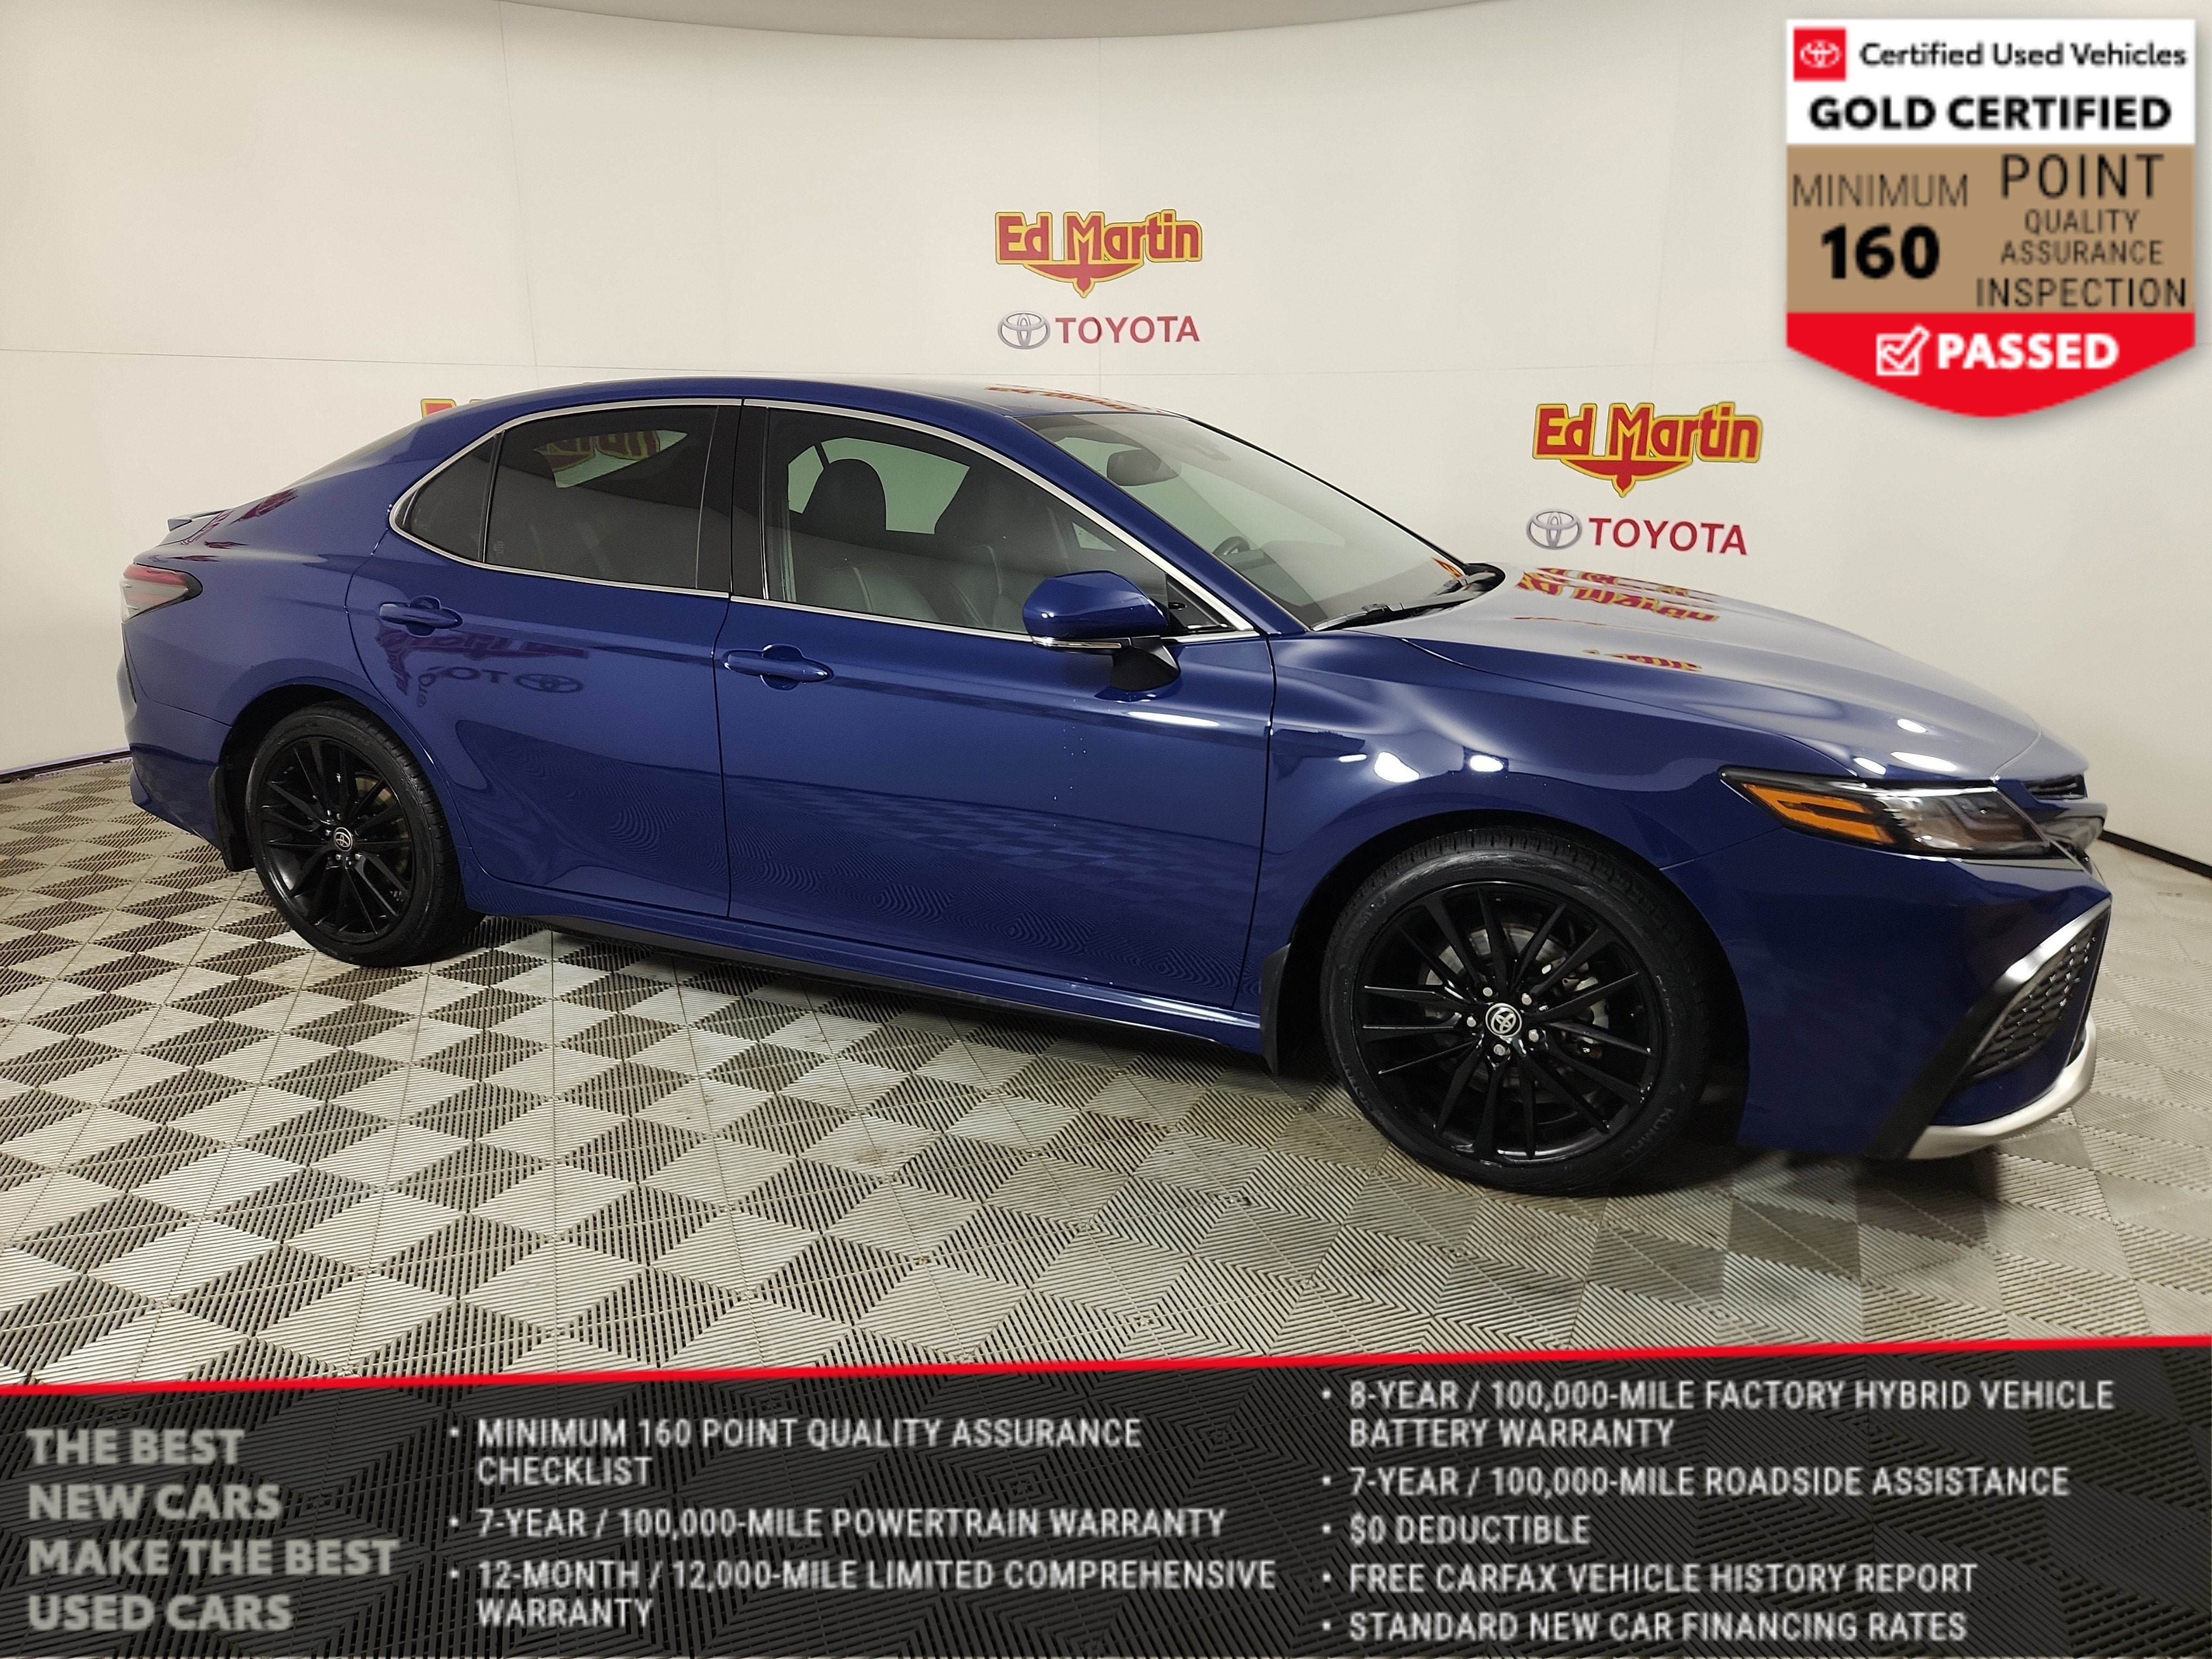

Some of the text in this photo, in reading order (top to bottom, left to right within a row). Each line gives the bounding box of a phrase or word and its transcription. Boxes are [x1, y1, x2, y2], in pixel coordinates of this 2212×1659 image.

[995, 209, 1203, 264] Ed Martin
[1055, 316, 1200, 344] TOYOTA
[1532, 401, 1763, 462] Ed Martin
[1589, 518, 1748, 556] TOYOTA
